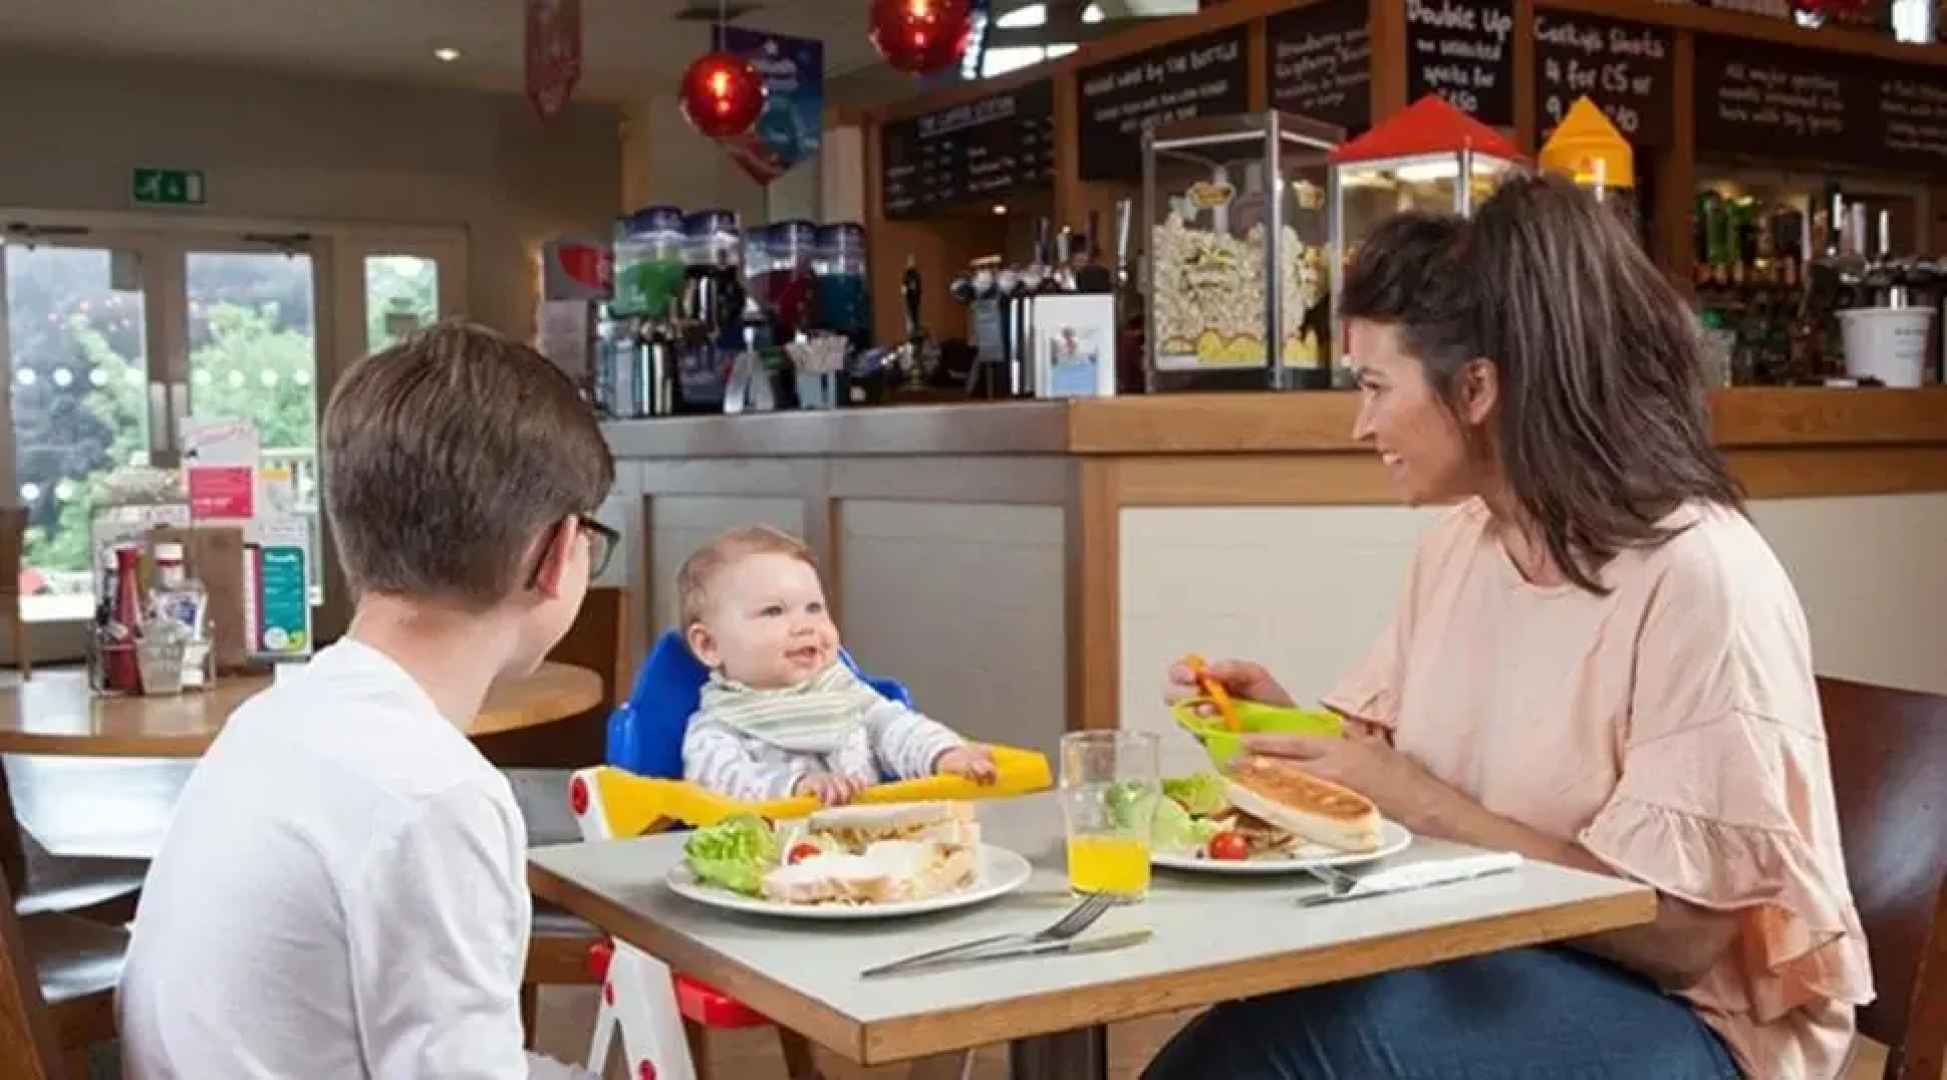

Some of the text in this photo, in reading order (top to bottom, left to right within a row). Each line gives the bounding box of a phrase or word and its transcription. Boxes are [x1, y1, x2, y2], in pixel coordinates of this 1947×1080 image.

[1406, 0, 1513, 42] Double Up
[1567, 58, 1597, 91] for
